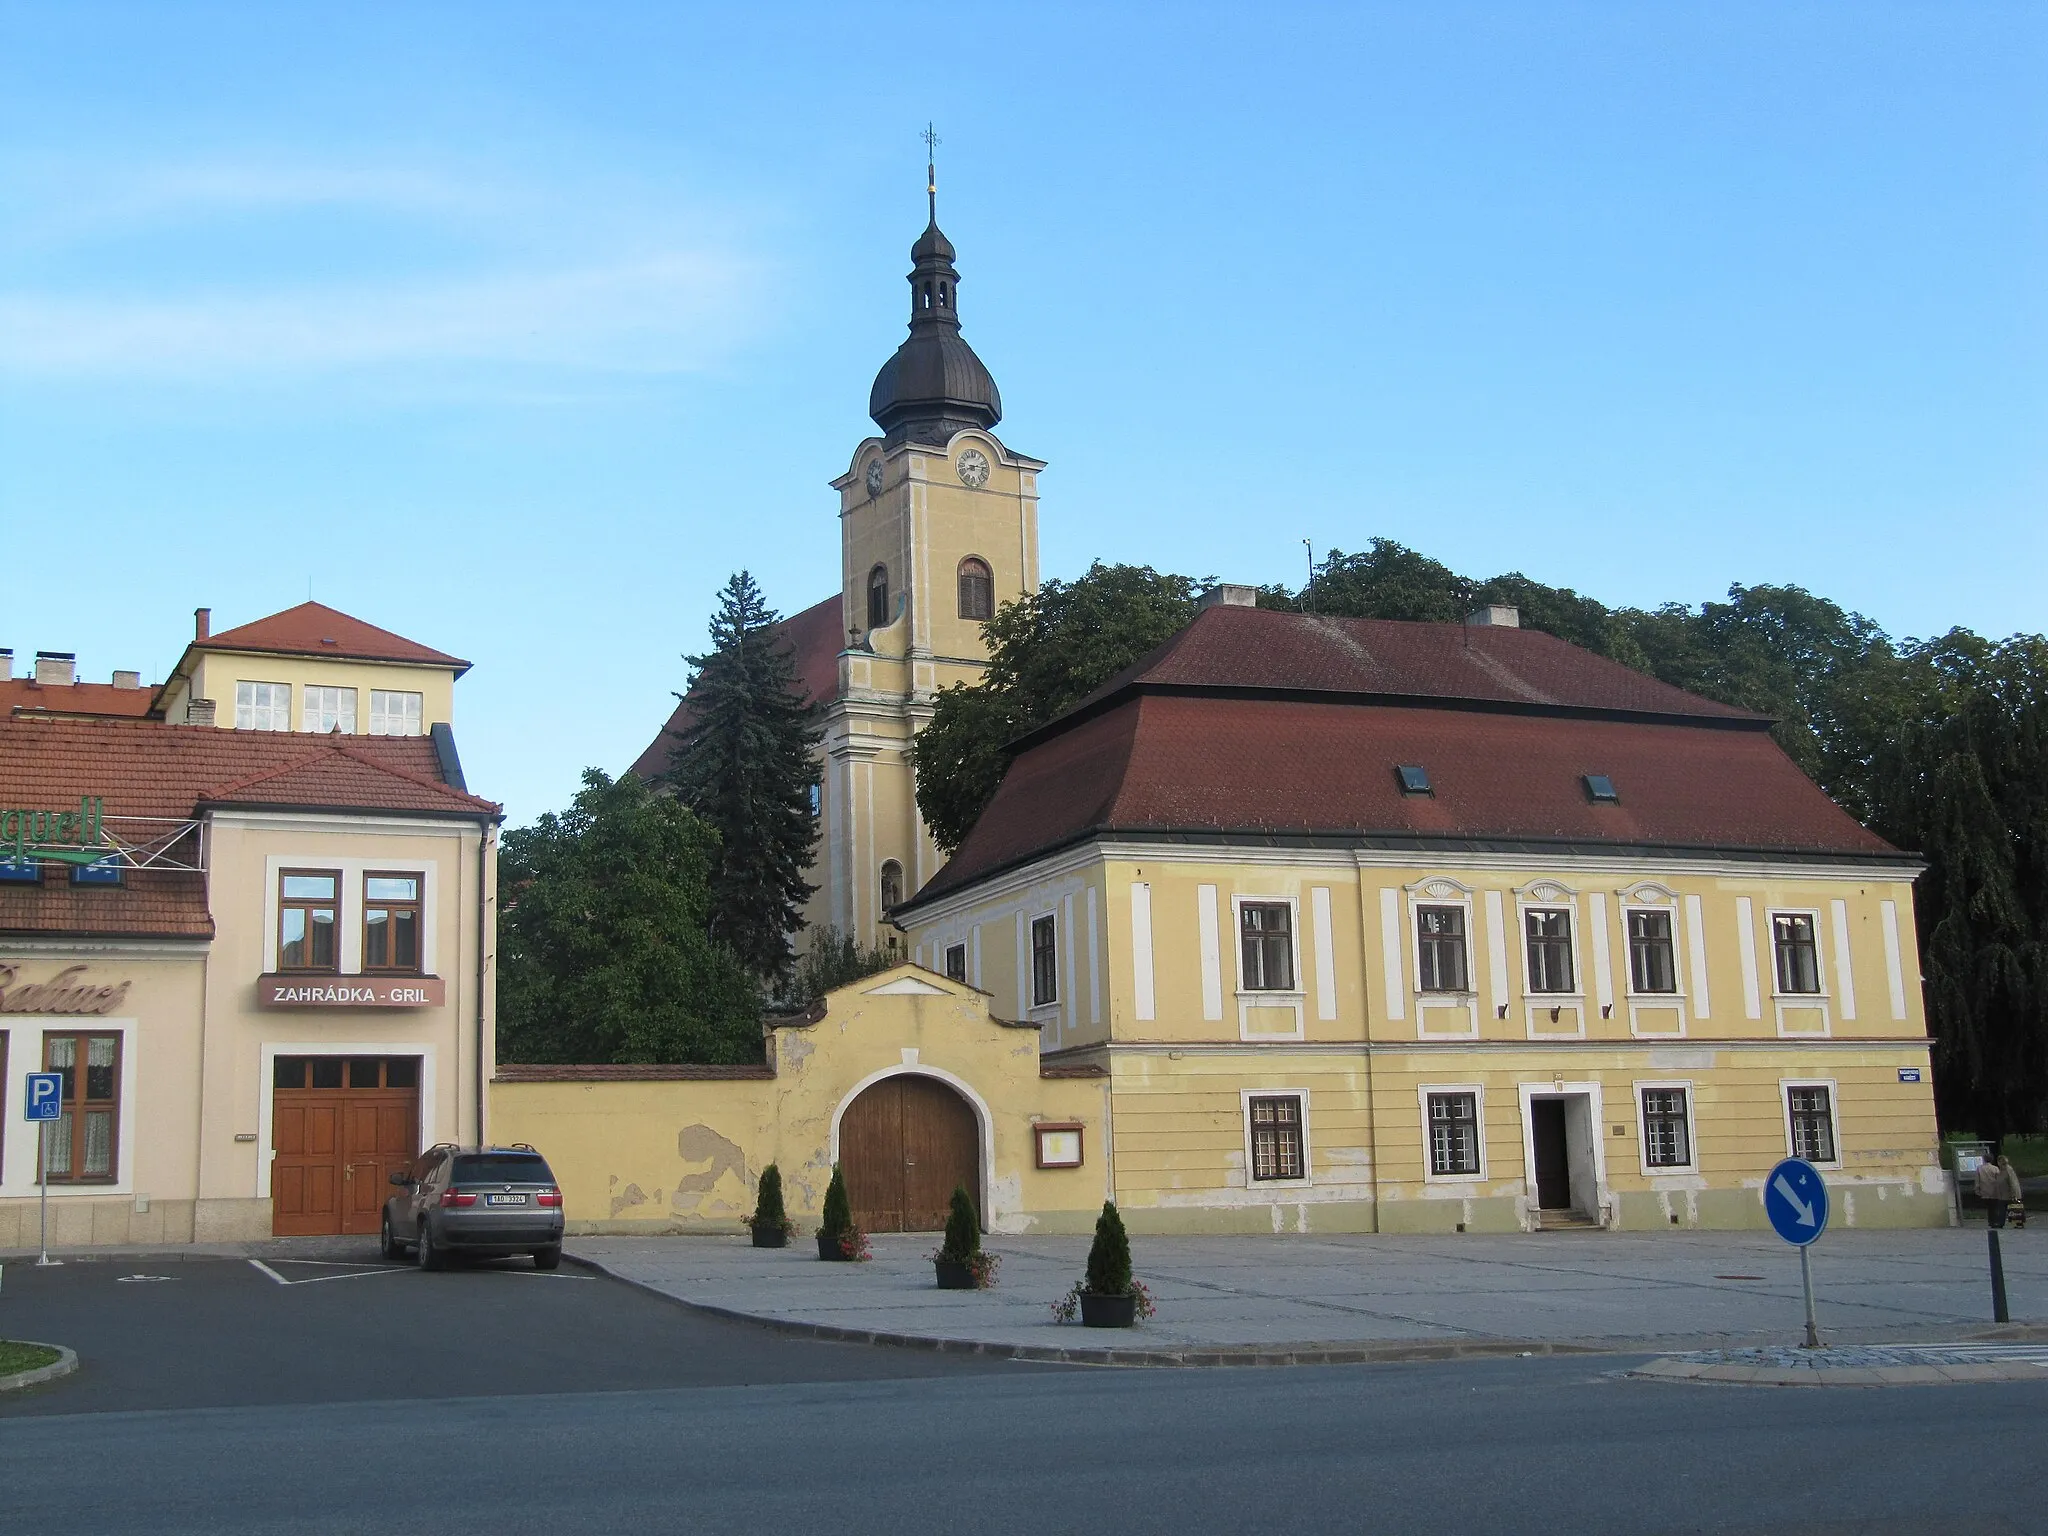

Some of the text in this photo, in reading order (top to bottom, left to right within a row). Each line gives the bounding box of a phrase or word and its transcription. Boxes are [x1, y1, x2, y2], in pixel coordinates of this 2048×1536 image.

[2, 796, 102, 864] quell
[274, 985, 375, 1002] ZAHRÁDKA
[390, 988, 429, 1002] GRIL
[33, 1079, 55, 1106] P
